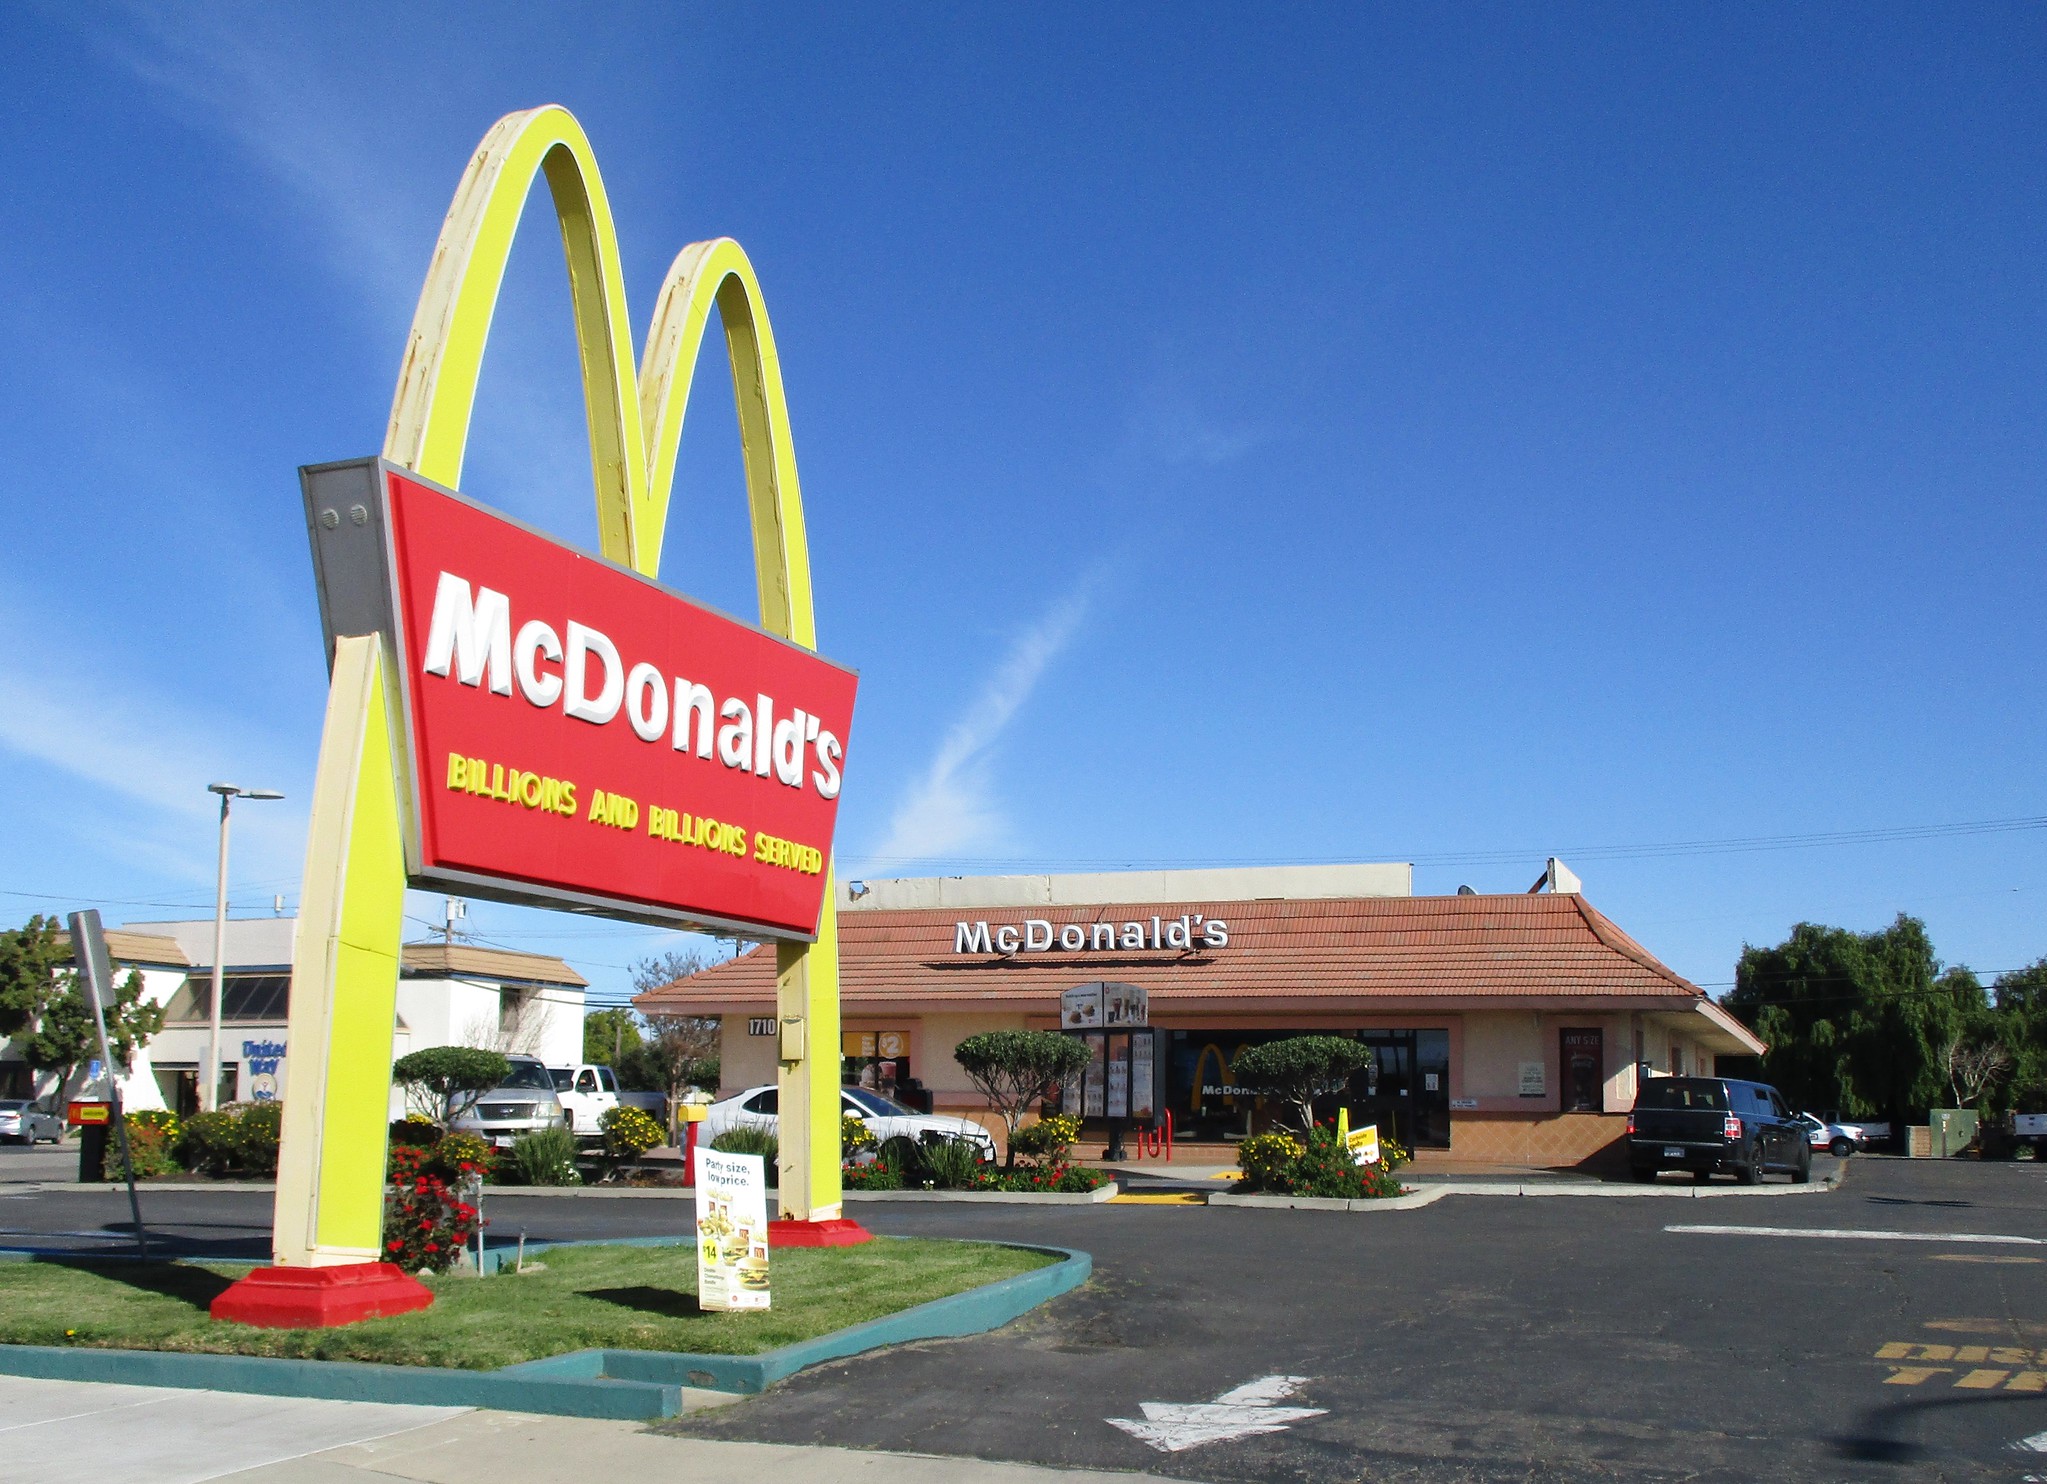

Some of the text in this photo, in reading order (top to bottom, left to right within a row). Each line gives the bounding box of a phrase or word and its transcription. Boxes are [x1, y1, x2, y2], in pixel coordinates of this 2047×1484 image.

[424, 571, 843, 800] McDonald's
[447, 752, 823, 875] BILLIONS AND BILLIONS SERVED
[954, 914, 1229, 954] McDonald's
[749, 1018, 776, 1035] 1710
[706, 1157, 724, 1174] Party
